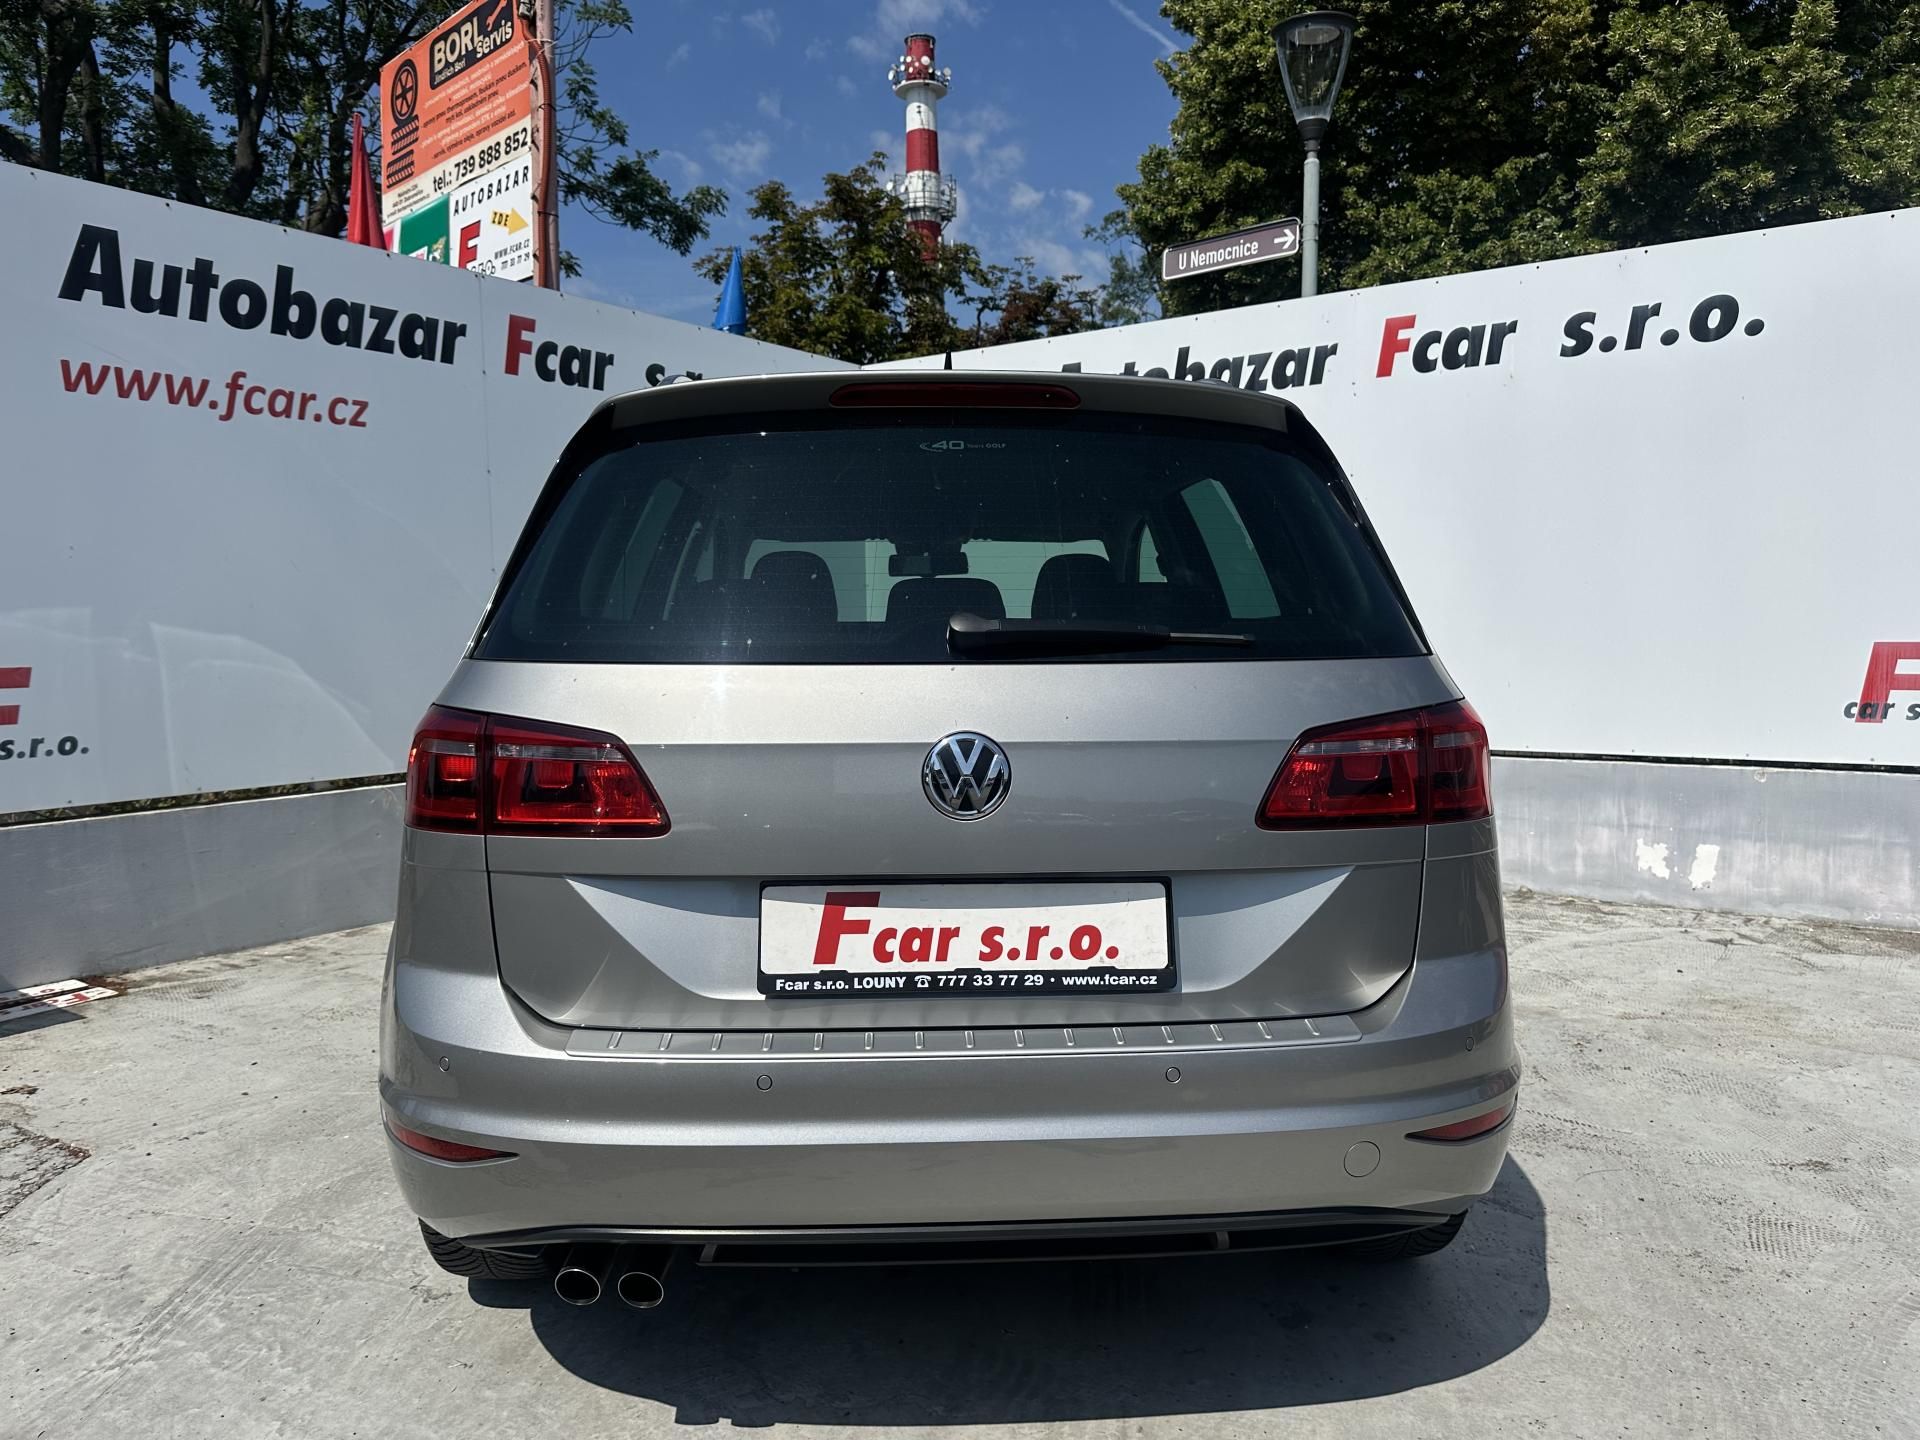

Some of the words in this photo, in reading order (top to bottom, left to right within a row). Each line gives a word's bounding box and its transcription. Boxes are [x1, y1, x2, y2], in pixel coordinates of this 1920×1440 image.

[476, 20, 512, 58] servis
[432, 169, 452, 192] tel.:
[454, 155, 475, 181] 739
[479, 141, 501, 169] 888
[504, 127, 528, 156] 852
[453, 165, 529, 217] AUTOBAZAR
[491, 211, 509, 227] ZDE
[1178, 252, 1187, 270] U
[1190, 239, 1259, 268] Nemocnice
[58, 224, 467, 366] Autobazar
[504, 314, 614, 391] Fcar
[1376, 314, 1518, 378] Fcar
[1560, 294, 1765, 358] s.r.o.
[60, 359, 369, 428] www.fcar.cz
[932, 440, 964, 450] 40
[1843, 701, 1896, 719] car
[813, 891, 960, 965] Fcar
[978, 925, 1119, 961] s.r.o.
[775, 979, 809, 990] Fcar
[813, 980, 849, 990] s.r.o.
[853, 976, 906, 989] LOUNY
[937, 975, 967, 986] 777
[973, 975, 993, 986] 33
[999, 975, 1020, 986] 77
[1024, 974, 1044, 985] 29
[1062, 973, 1158, 986] www.fcar.cz
